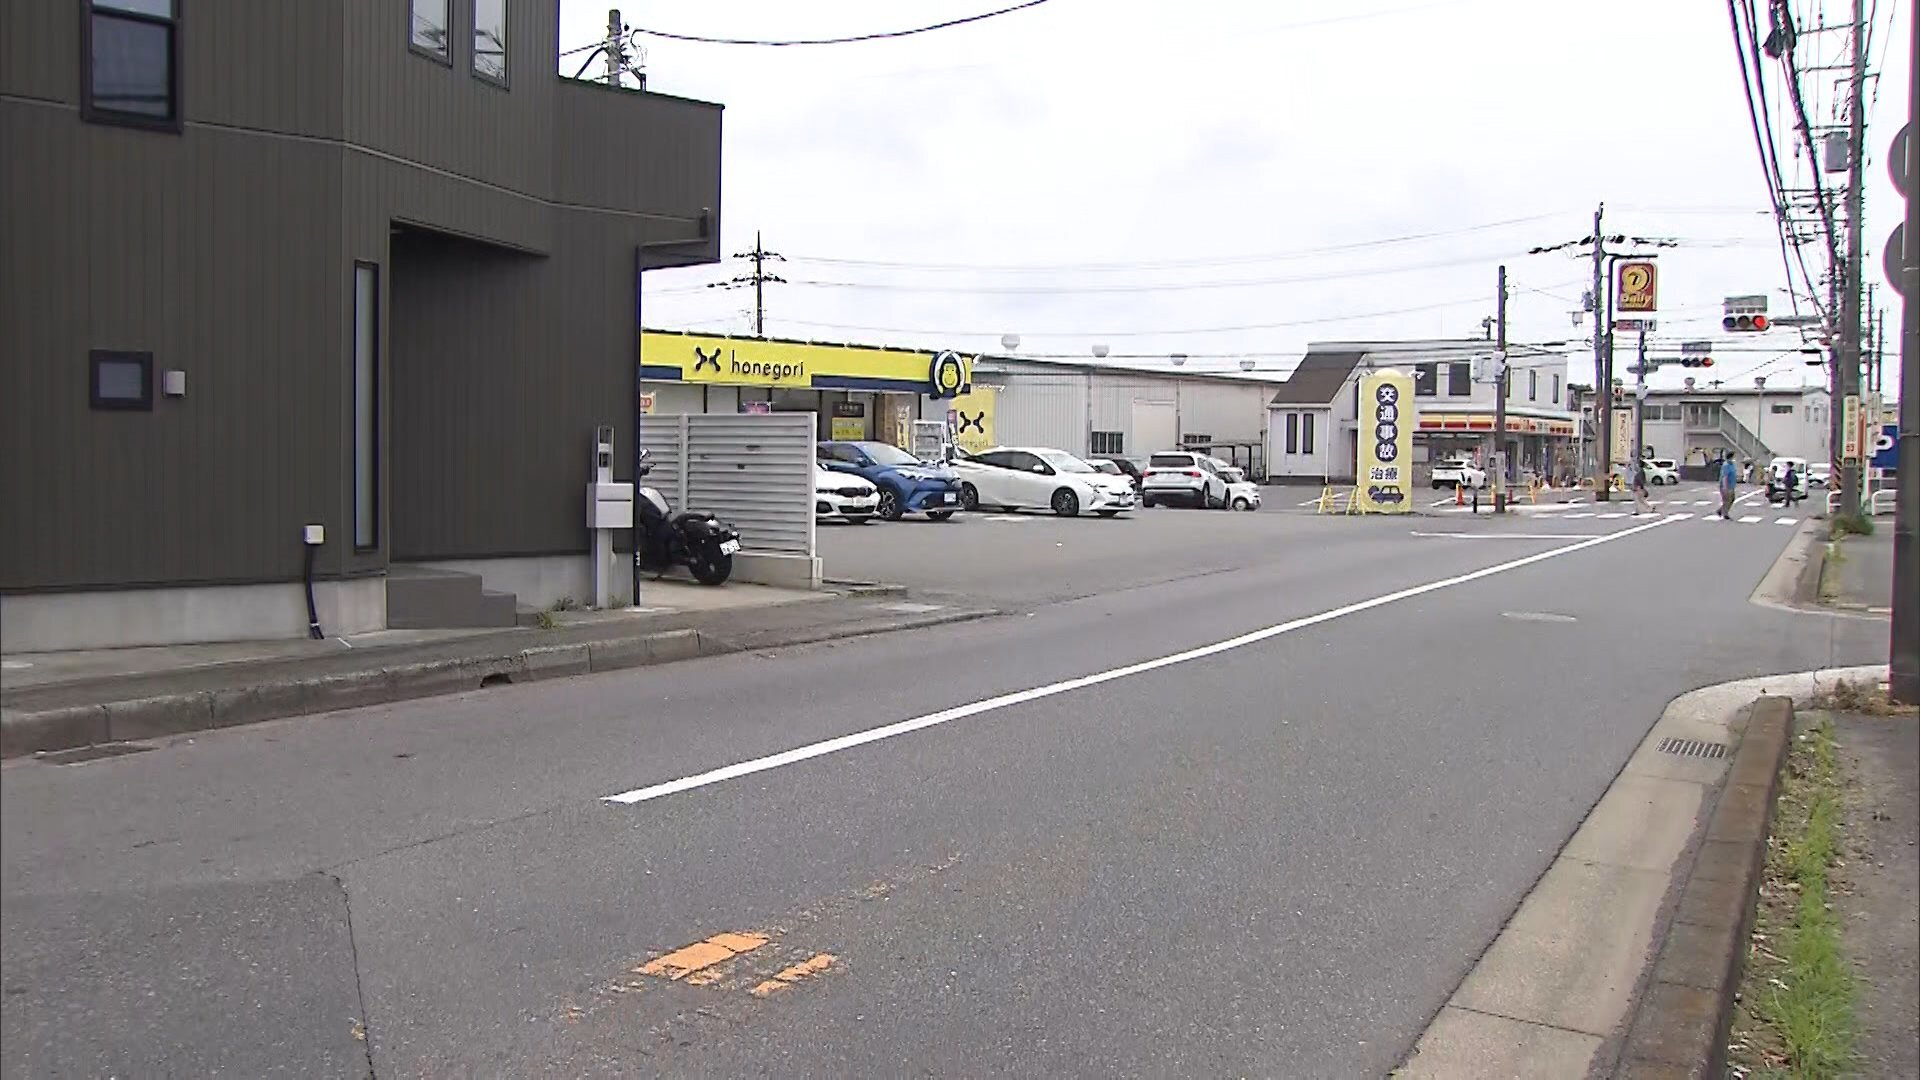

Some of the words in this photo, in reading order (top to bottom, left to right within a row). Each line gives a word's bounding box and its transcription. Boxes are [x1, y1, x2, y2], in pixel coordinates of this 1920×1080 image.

[731, 349, 804, 380] honegori
[1378, 386, 1397, 458] 交通事故
[1370, 467, 1398, 481] 治療
